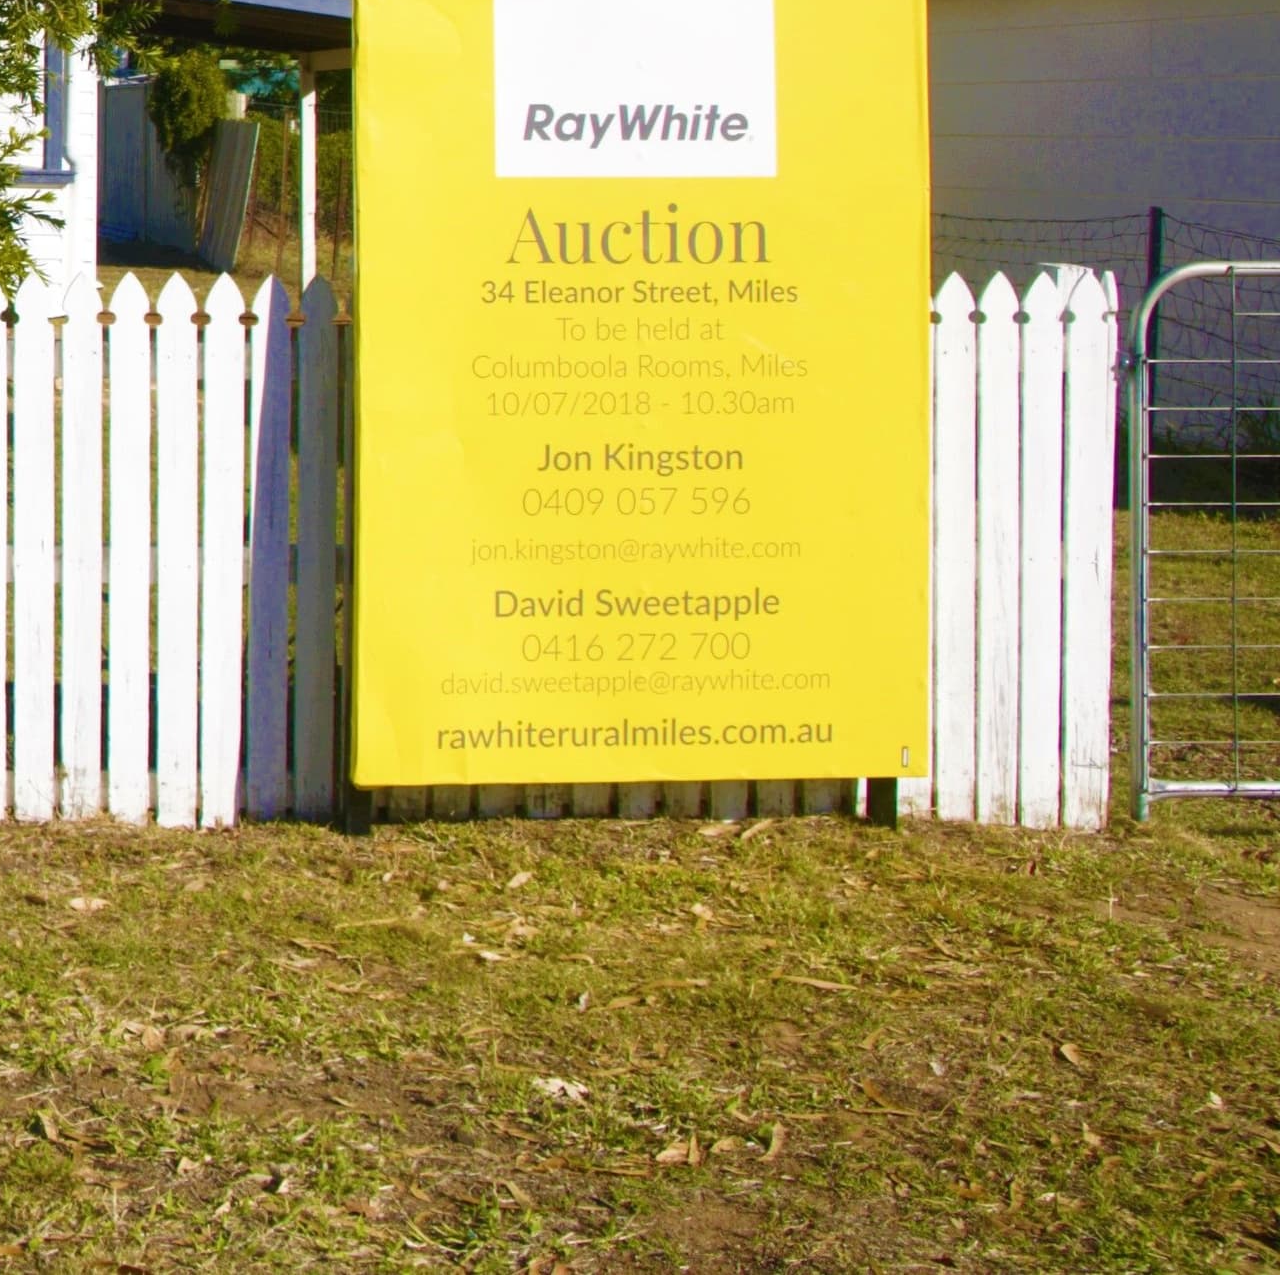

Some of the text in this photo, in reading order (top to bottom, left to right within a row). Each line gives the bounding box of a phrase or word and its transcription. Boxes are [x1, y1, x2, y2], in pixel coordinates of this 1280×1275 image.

[505, 203, 772, 266] Auction
[480, 278, 799, 306] 34 Eleanor Street, Miles
[555, 317, 725, 342] To be held at
[471, 353, 808, 380] Columboola Rooms, Miles
[487, 391, 652, 417] 10/07/2018
[681, 390, 795, 416] 10.30am
[536, 442, 744, 477] Jon Kingston
[521, 486, 751, 517] 0409 057 596
[470, 537, 802, 566] jon.kingston@raywhite.com
[493, 587, 781, 622] David Sweetapple
[521, 631, 751, 662] 0416 272 700
[440, 668, 831, 697] david.sweetapple@raywhite.com
[436, 718, 833, 750] rawhiteruralmiles.com.au
